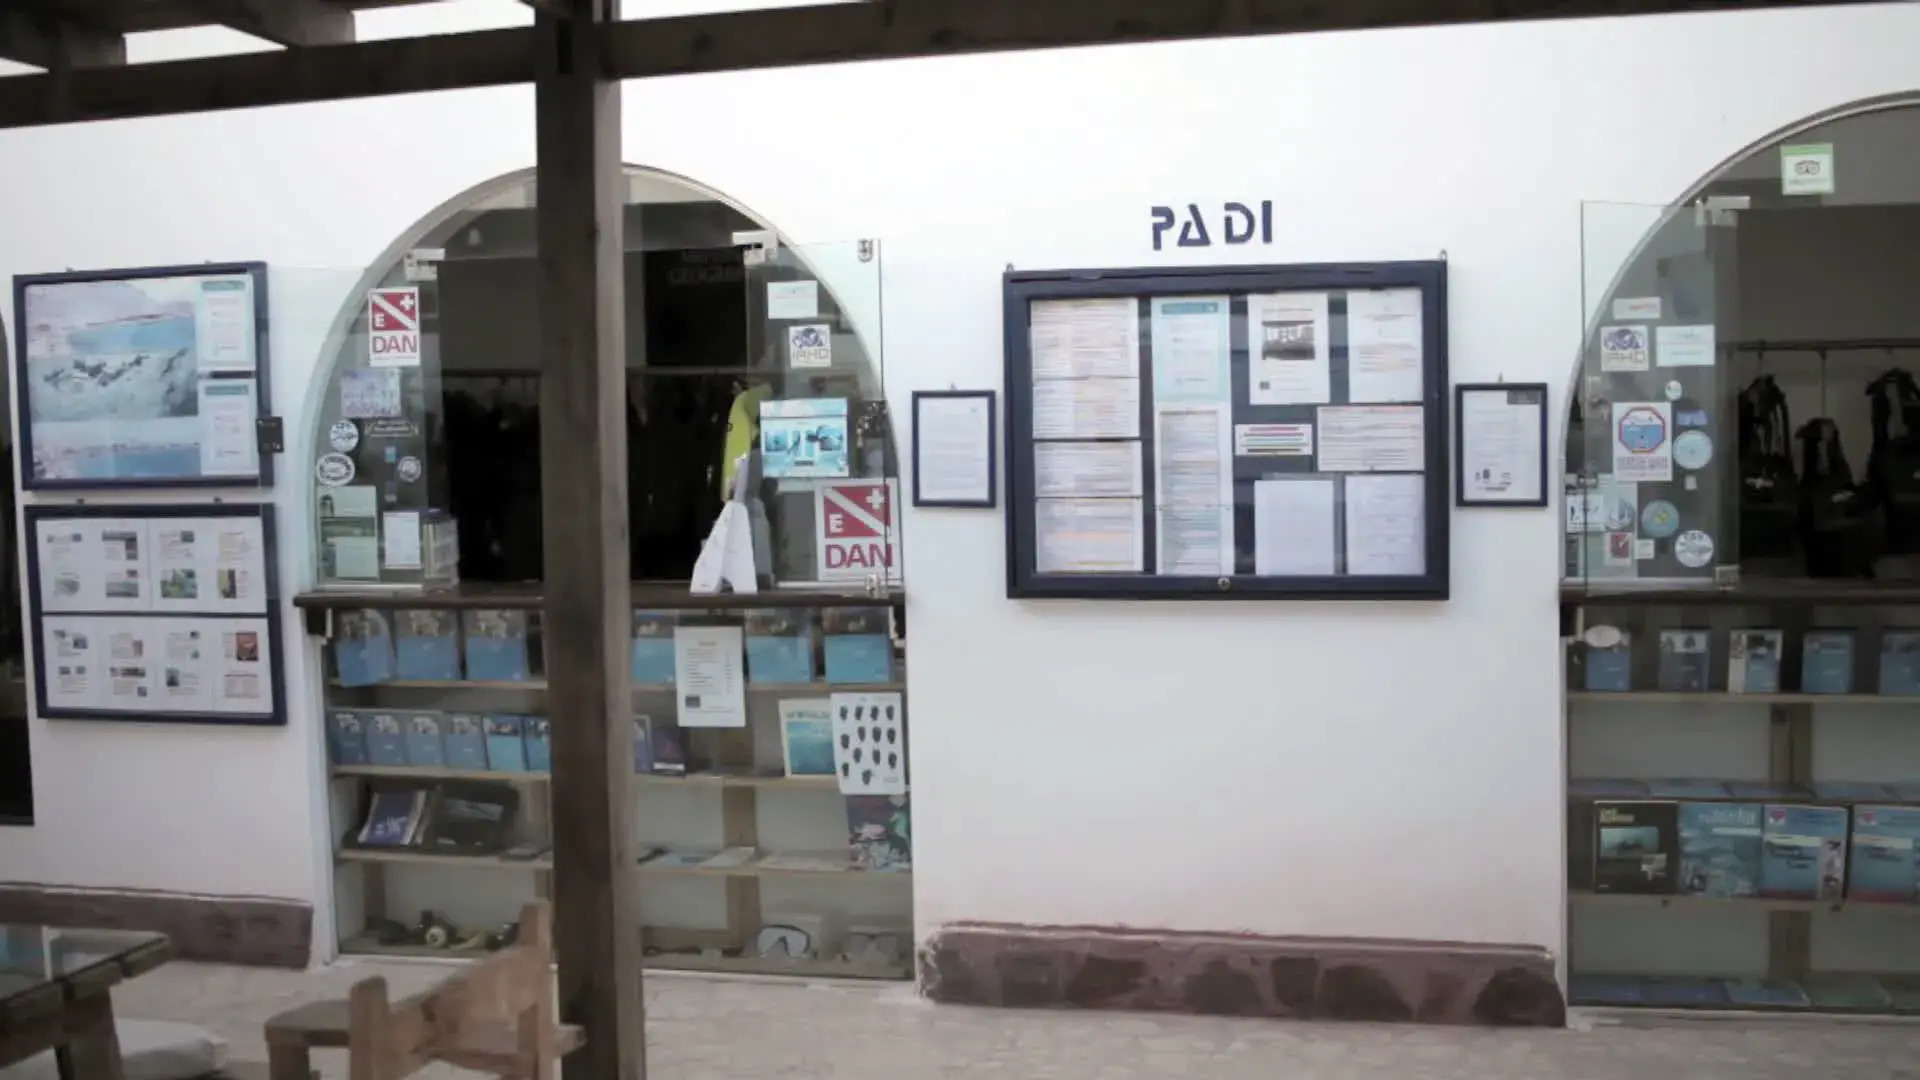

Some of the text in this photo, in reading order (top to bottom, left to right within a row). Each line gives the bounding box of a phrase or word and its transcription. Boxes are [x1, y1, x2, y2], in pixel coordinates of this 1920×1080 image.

[1151, 200, 1273, 250] PADI
[375, 313, 385, 327] E
[371, 335, 418, 353] DAN
[829, 513, 844, 533] E
[825, 543, 893, 569] DAN
